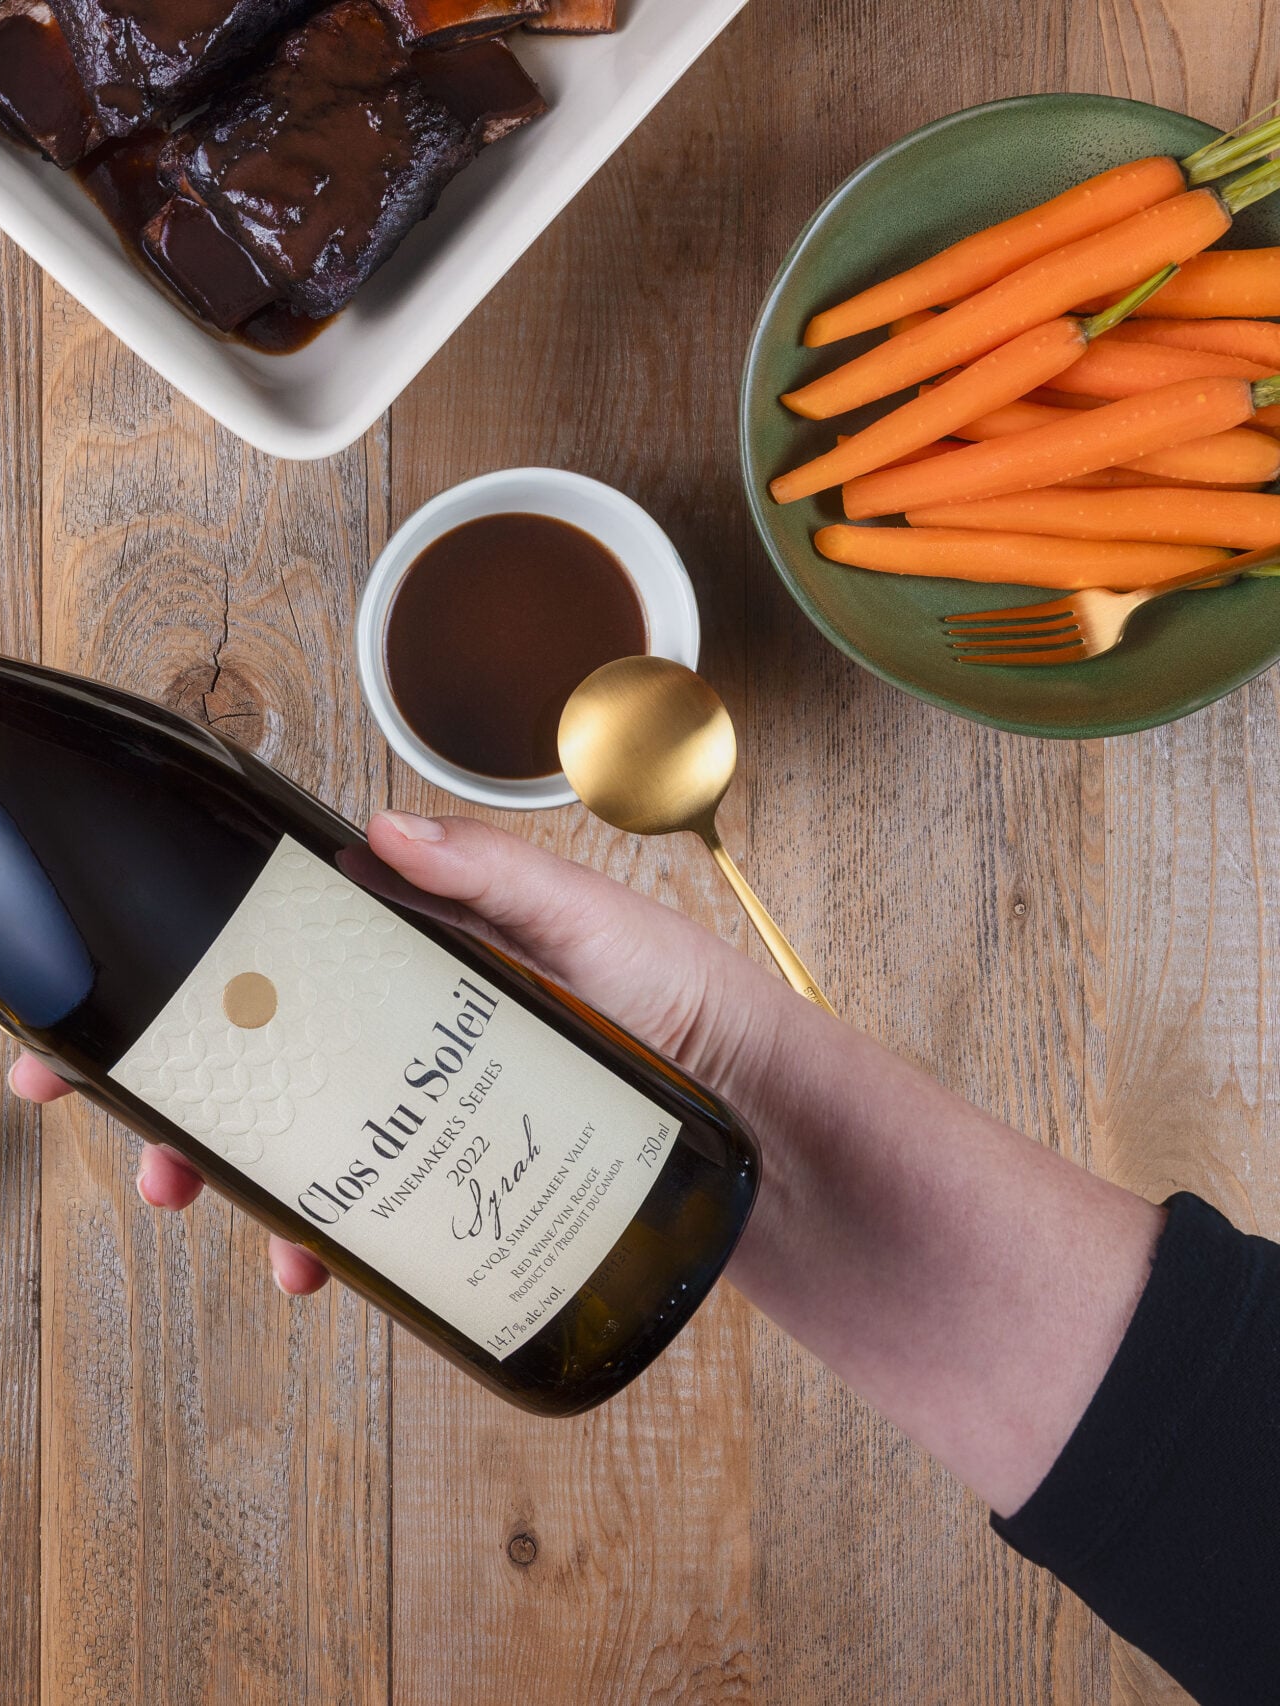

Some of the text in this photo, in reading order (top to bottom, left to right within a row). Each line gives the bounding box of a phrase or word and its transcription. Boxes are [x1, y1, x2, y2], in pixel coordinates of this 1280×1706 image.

[297, 977, 499, 1225] Clos du Soleil
[458, 1059, 503, 1114] SERIES
[446, 1135, 491, 1187] 2022
[451, 1114, 541, 1240] Syrah
[637, 1122, 670, 1168] 750 ml
[466, 1121, 596, 1287] BC VQA SIMILKAMEEN VALLEY
[509, 1264, 547, 1303] PRODUCT
[589, 1196, 601, 1212] DU
[595, 1158, 625, 1197] CANADA
[510, 1258, 532, 1279] RED
[570, 1166, 601, 1206] ROUGE
[525, 1286, 566, 1325] alc./vol.
